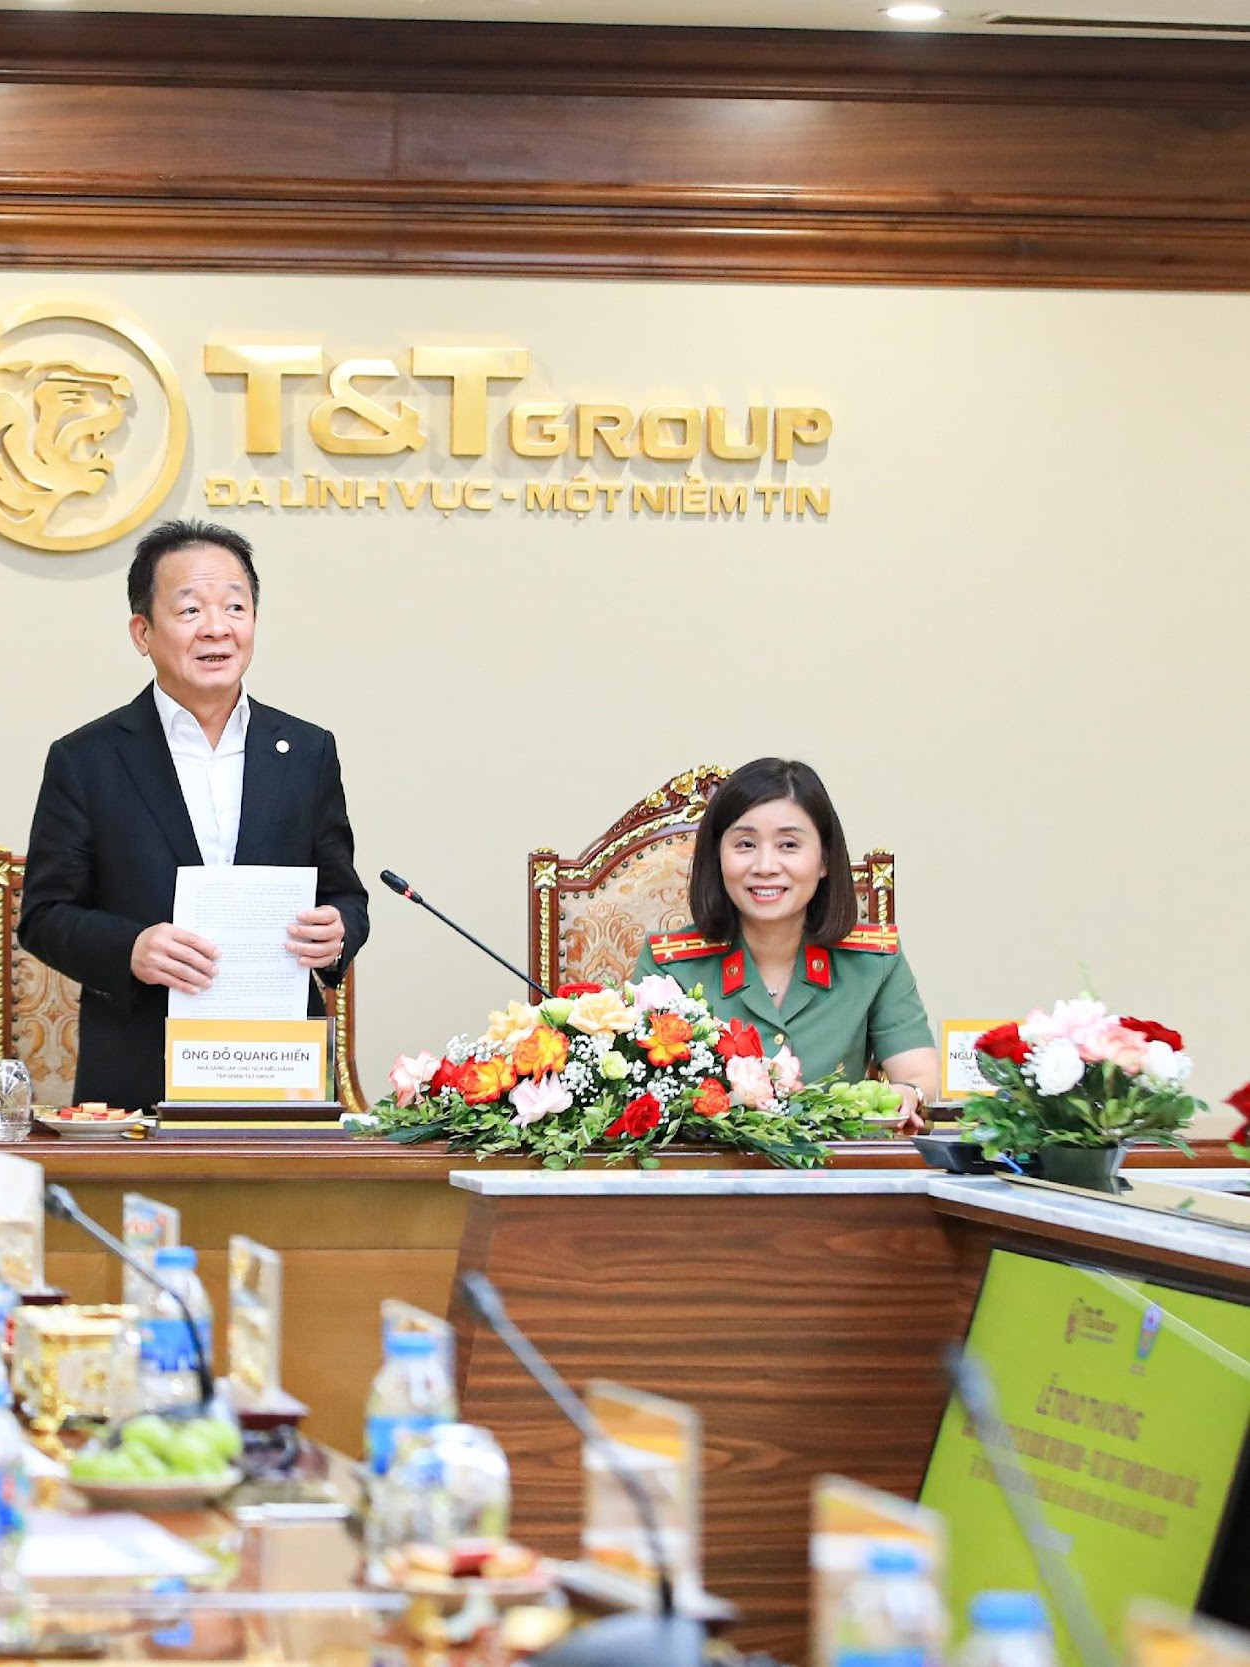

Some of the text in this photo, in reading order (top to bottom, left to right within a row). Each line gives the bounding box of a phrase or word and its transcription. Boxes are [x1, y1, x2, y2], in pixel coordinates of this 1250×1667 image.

[205, 344, 832, 461] T&T GROUP
[205, 476, 270, 507] ĐA
[279, 473, 387, 508] LĨNH
[395, 478, 493, 518] VỰC
[525, 476, 624, 518] MỘT
[632, 471, 748, 514] NIỀM
[755, 484, 831, 515] TIN
[182, 1049, 209, 1060] ÔNG
[233, 1051, 278, 1062] QUANG
